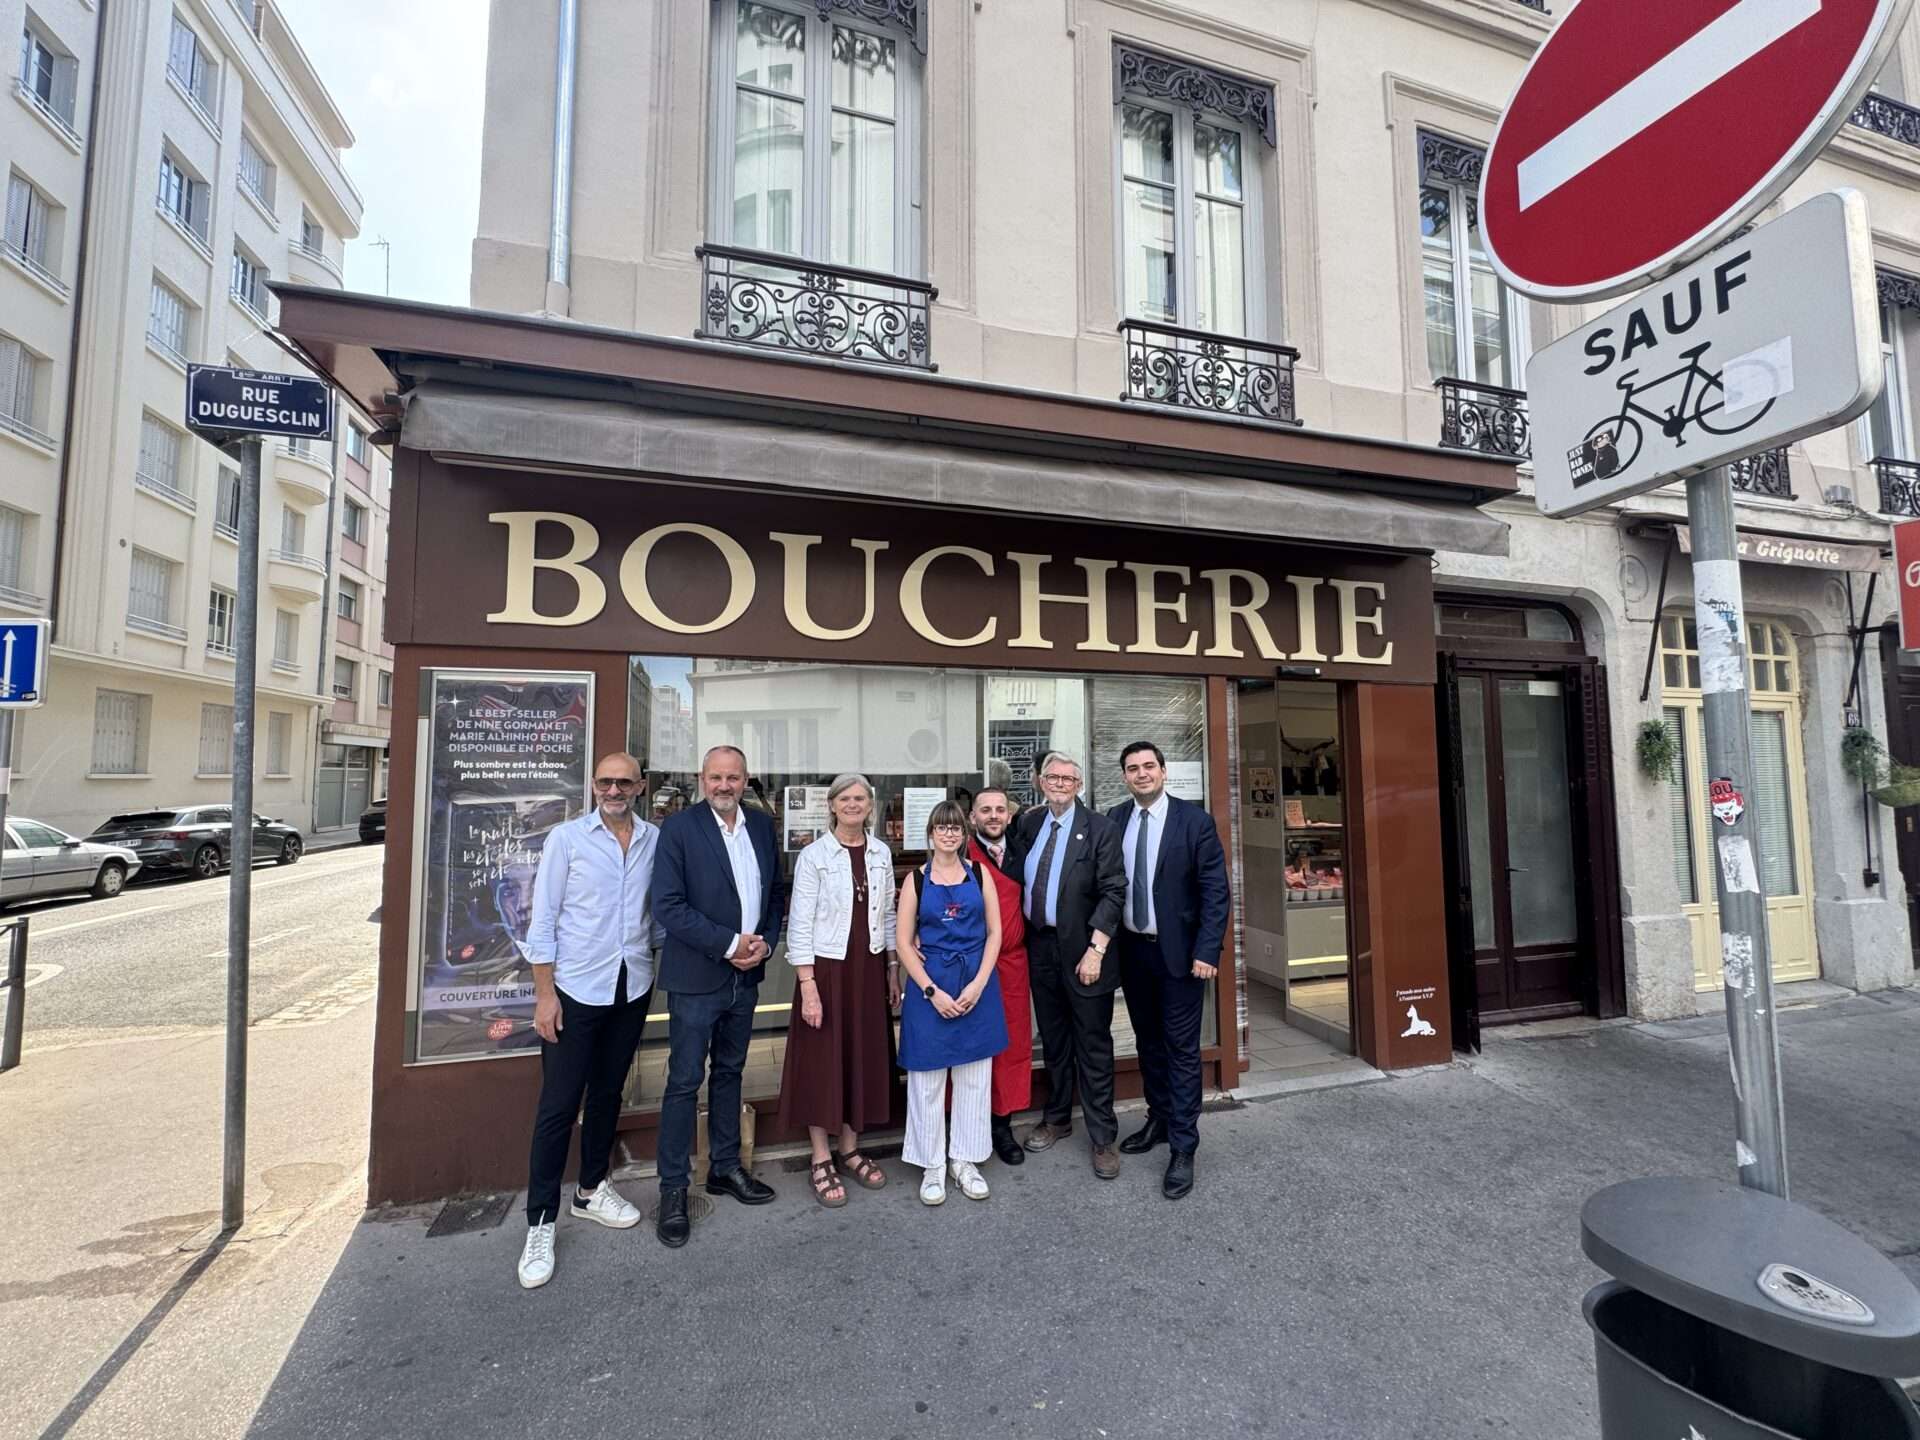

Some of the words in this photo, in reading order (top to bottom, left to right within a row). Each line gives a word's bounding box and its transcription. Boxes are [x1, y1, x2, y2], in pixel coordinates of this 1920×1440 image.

[1584, 250, 1752, 375] SAUF
[242, 386, 280, 404] RUE
[199, 401, 320, 428] DUGUESCLIN
[1737, 541, 1748, 554] a
[1756, 541, 1840, 564] Grignotte
[487, 511, 1394, 665] BOUCHERIE
[469, 708, 483, 718] LE
[485, 709, 557, 719] BEST-SELLER
[456, 720, 472, 729] DE
[474, 720, 501, 729] NINE
[503, 721, 552, 730] GORMAN
[555, 721, 568, 730] ET
[449, 732, 485, 741] MARIE
[487, 732, 538, 742] ALHINHO
[541, 733, 573, 742] ENFIN
[448, 743, 516, 753] DISPONIBLE
[518, 744, 534, 753] EN
[535, 744, 573, 753] POCHE
[453, 760, 474, 769] Plus
[475, 760, 511, 769] sombre
[512, 761, 527, 769] est
[528, 760, 537, 769] le
[460, 771, 480, 781] plus
[481, 770, 505, 779] belle
[528, 770, 559, 779] l'étoile
[440, 989, 517, 1002] COUVERTURE
